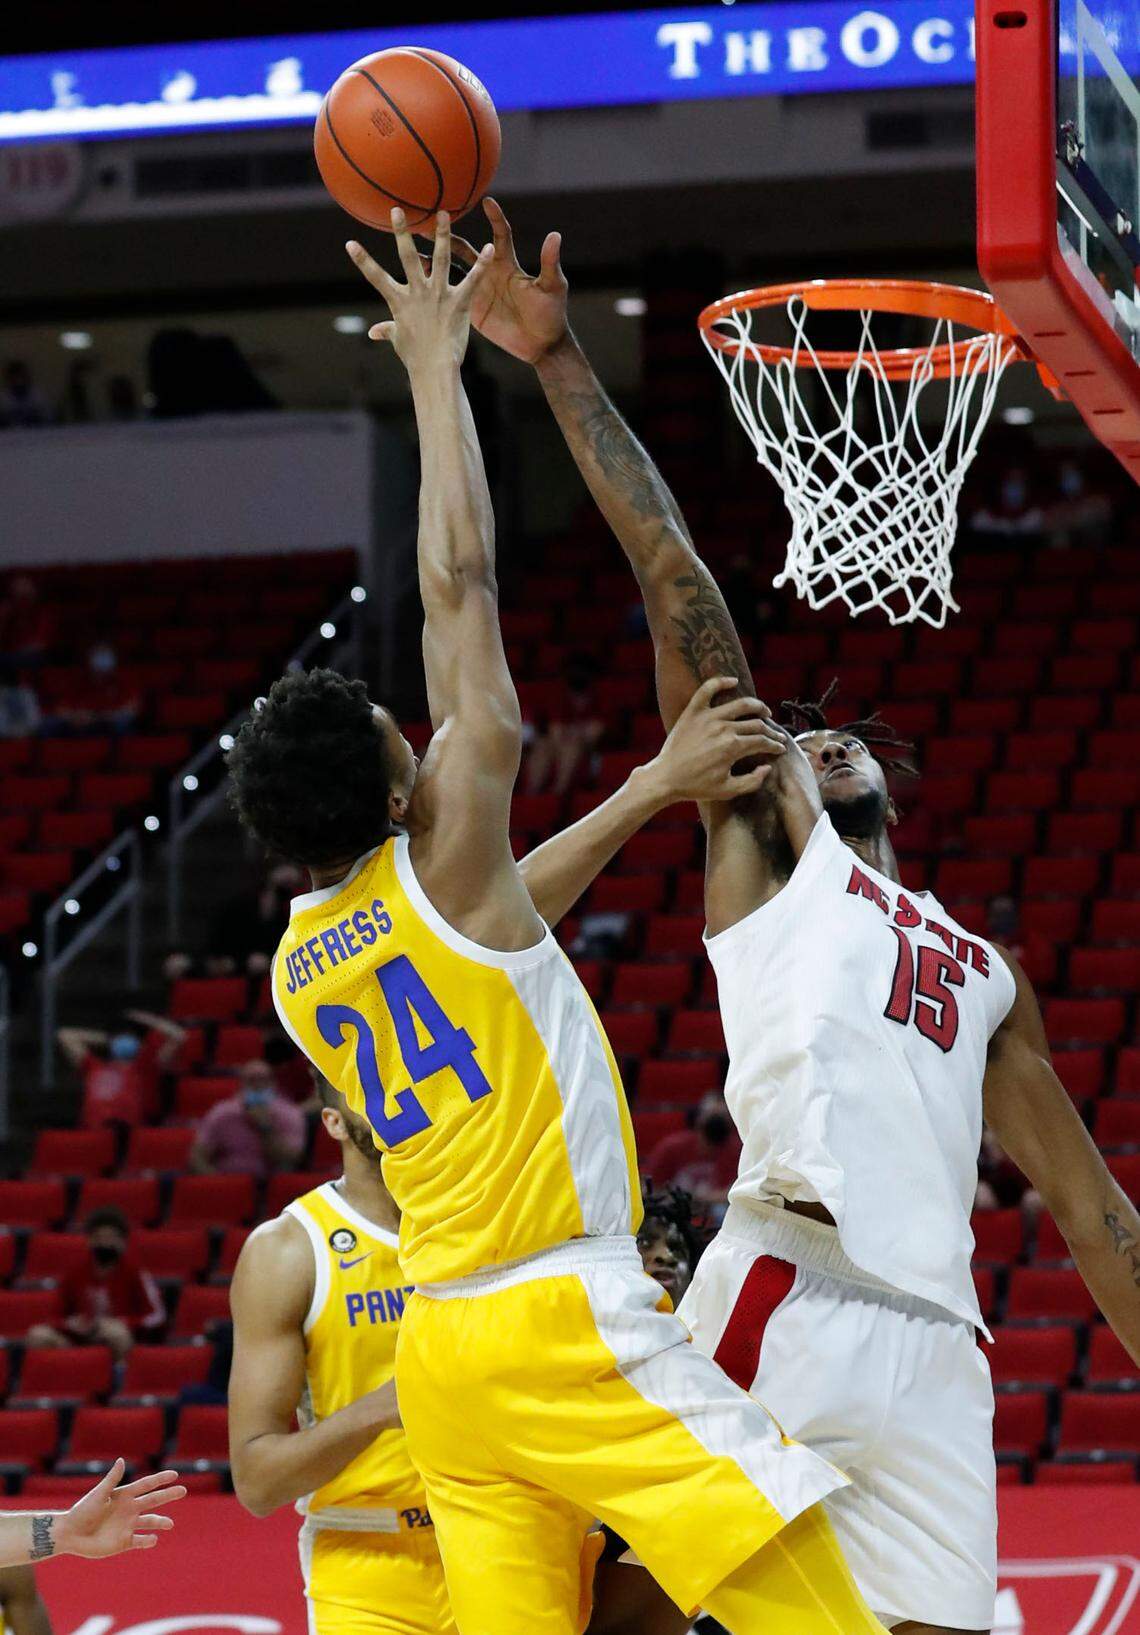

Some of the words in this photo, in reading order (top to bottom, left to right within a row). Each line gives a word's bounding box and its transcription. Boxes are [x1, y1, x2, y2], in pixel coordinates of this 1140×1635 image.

[285, 899, 393, 995] JEFFRESS
[884, 925, 966, 1054] 15
[315, 954, 494, 1148] 24
